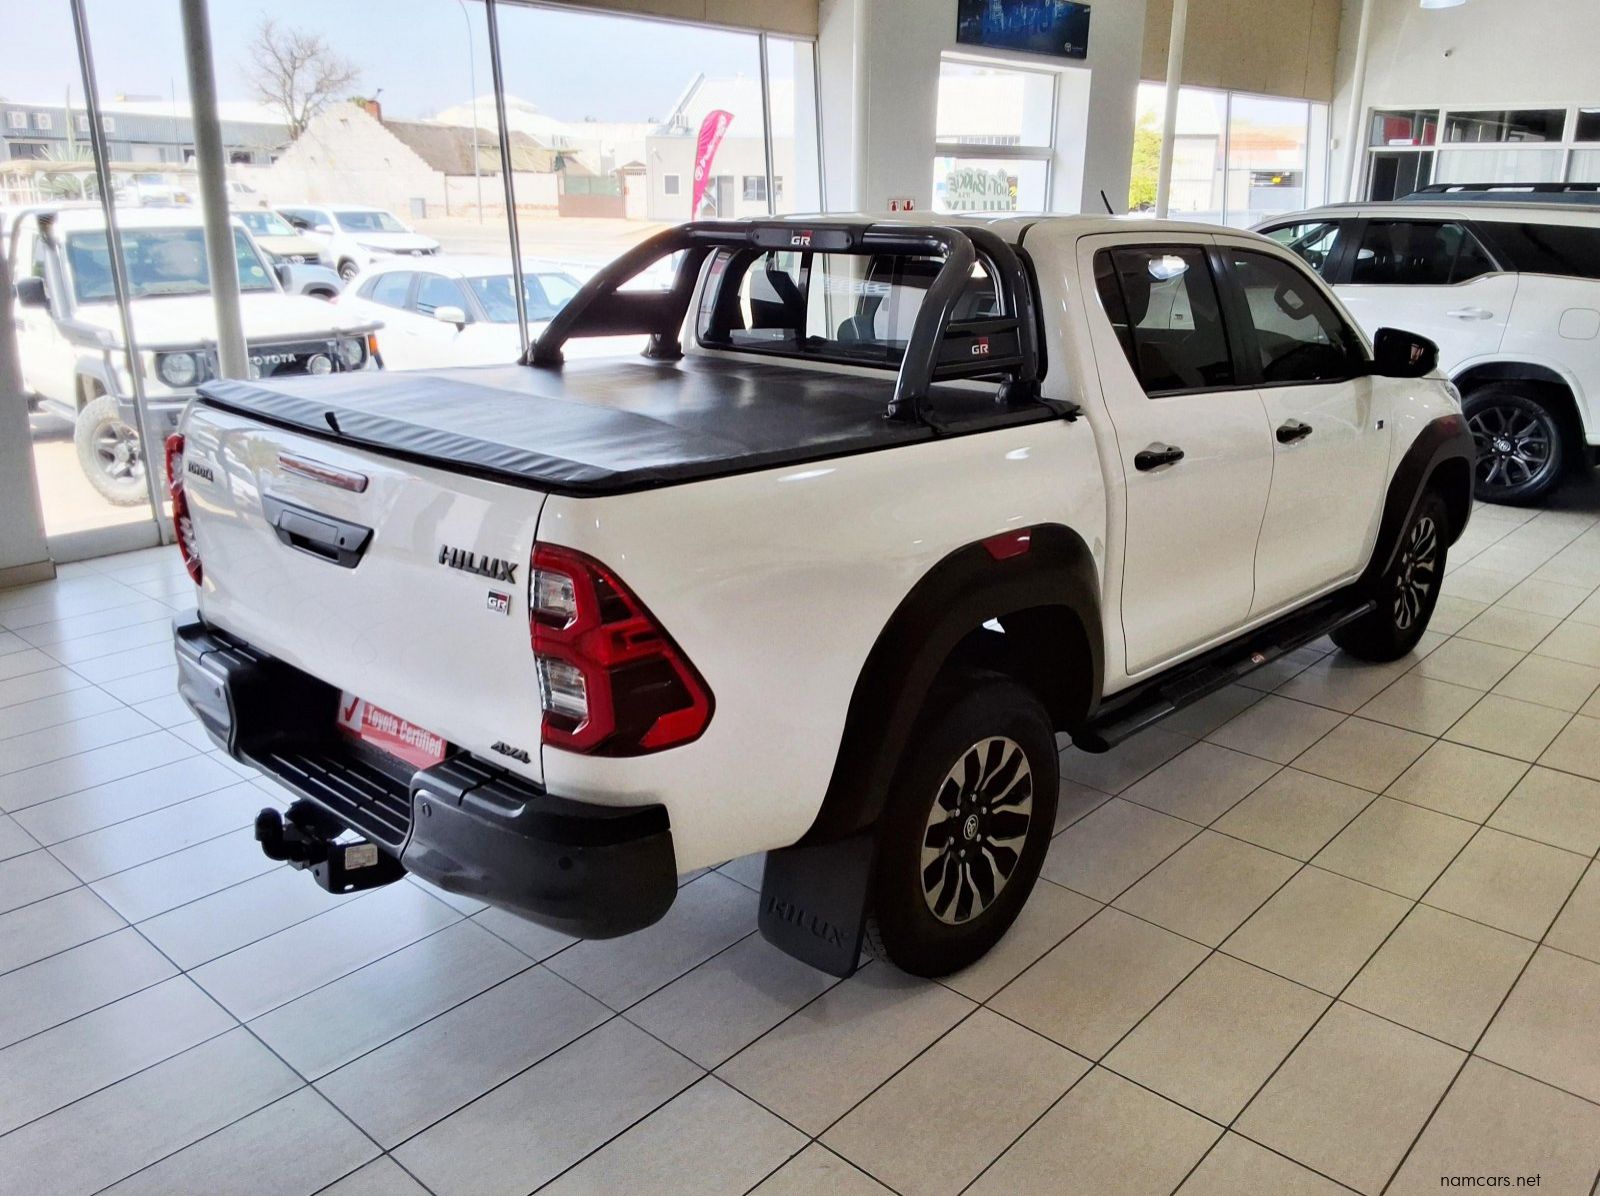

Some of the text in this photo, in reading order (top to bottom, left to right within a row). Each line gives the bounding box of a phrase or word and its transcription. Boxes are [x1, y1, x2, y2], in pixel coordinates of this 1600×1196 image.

[791, 235, 811, 246] GR
[971, 343, 989, 355] GR
[248, 353, 297, 366] OYOTA
[438, 543, 519, 585] HILUX
[488, 596, 508, 610] GR
[366, 704, 443, 758] Toyota Certified
[767, 896, 845, 949] HILUX
